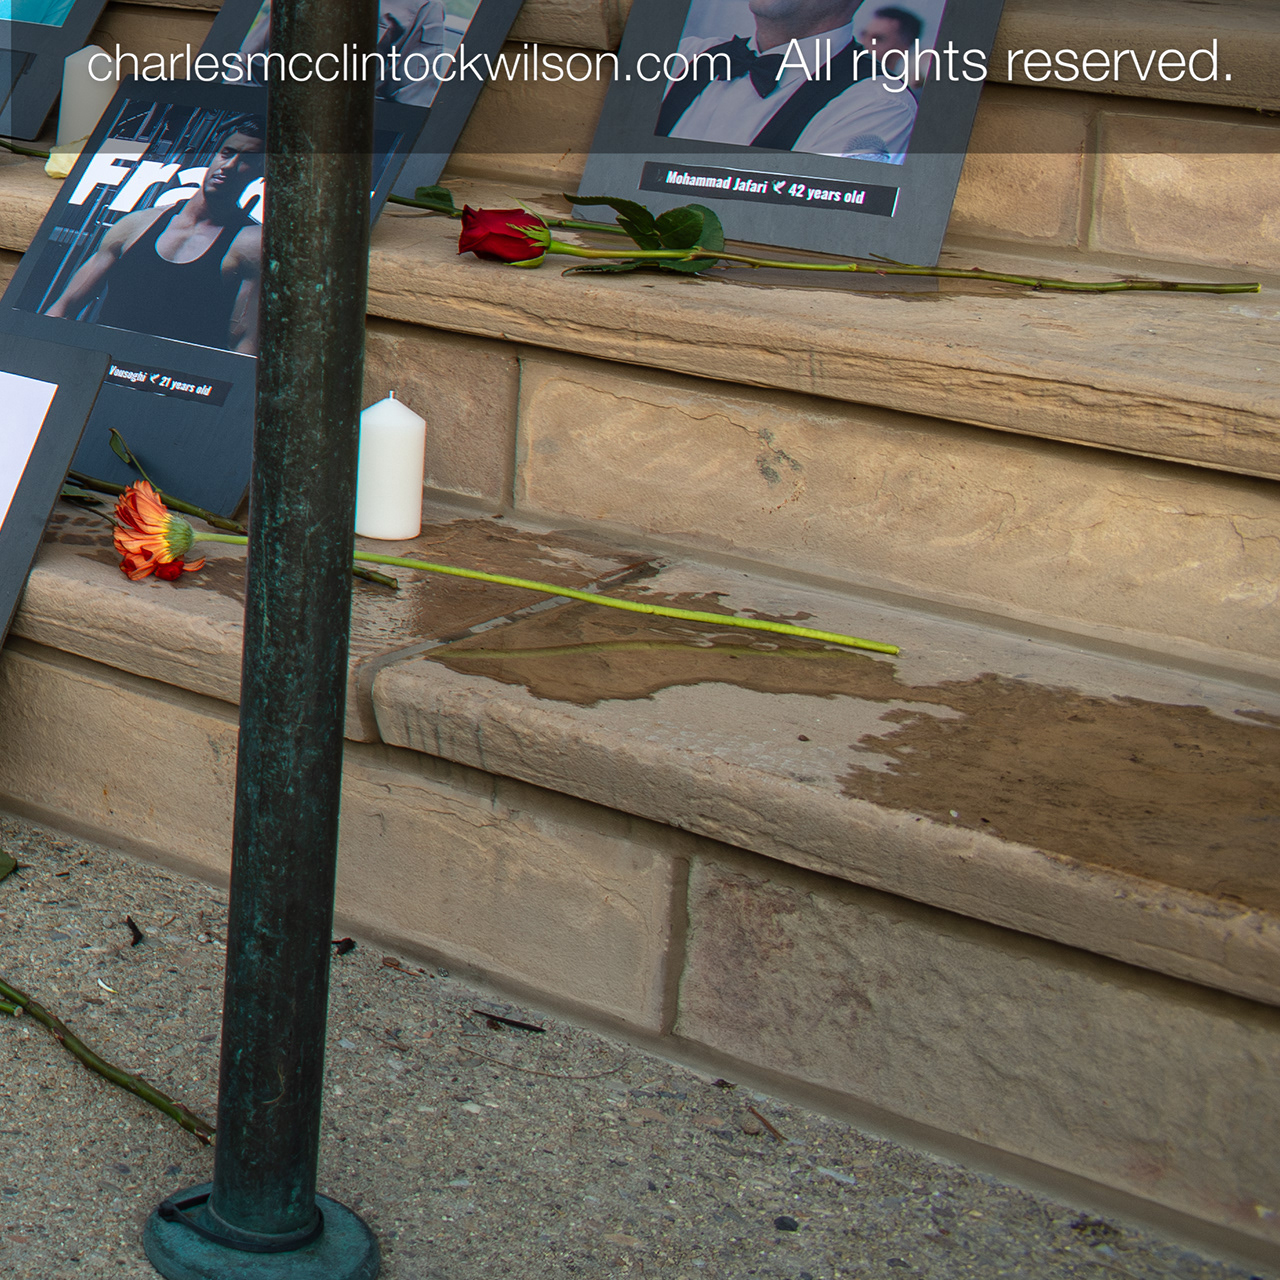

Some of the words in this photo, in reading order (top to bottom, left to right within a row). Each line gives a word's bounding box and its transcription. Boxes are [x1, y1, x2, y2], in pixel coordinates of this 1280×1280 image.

[666, 170, 732, 190] Mohammad
[733, 177, 768, 194] Jafari
[788, 183, 804, 198] 42
[806, 185, 842, 202] years
[843, 188, 865, 205] old
[158, 376, 171, 388] 21
[170, 380, 195, 394] years
[195, 385, 213, 397] old
